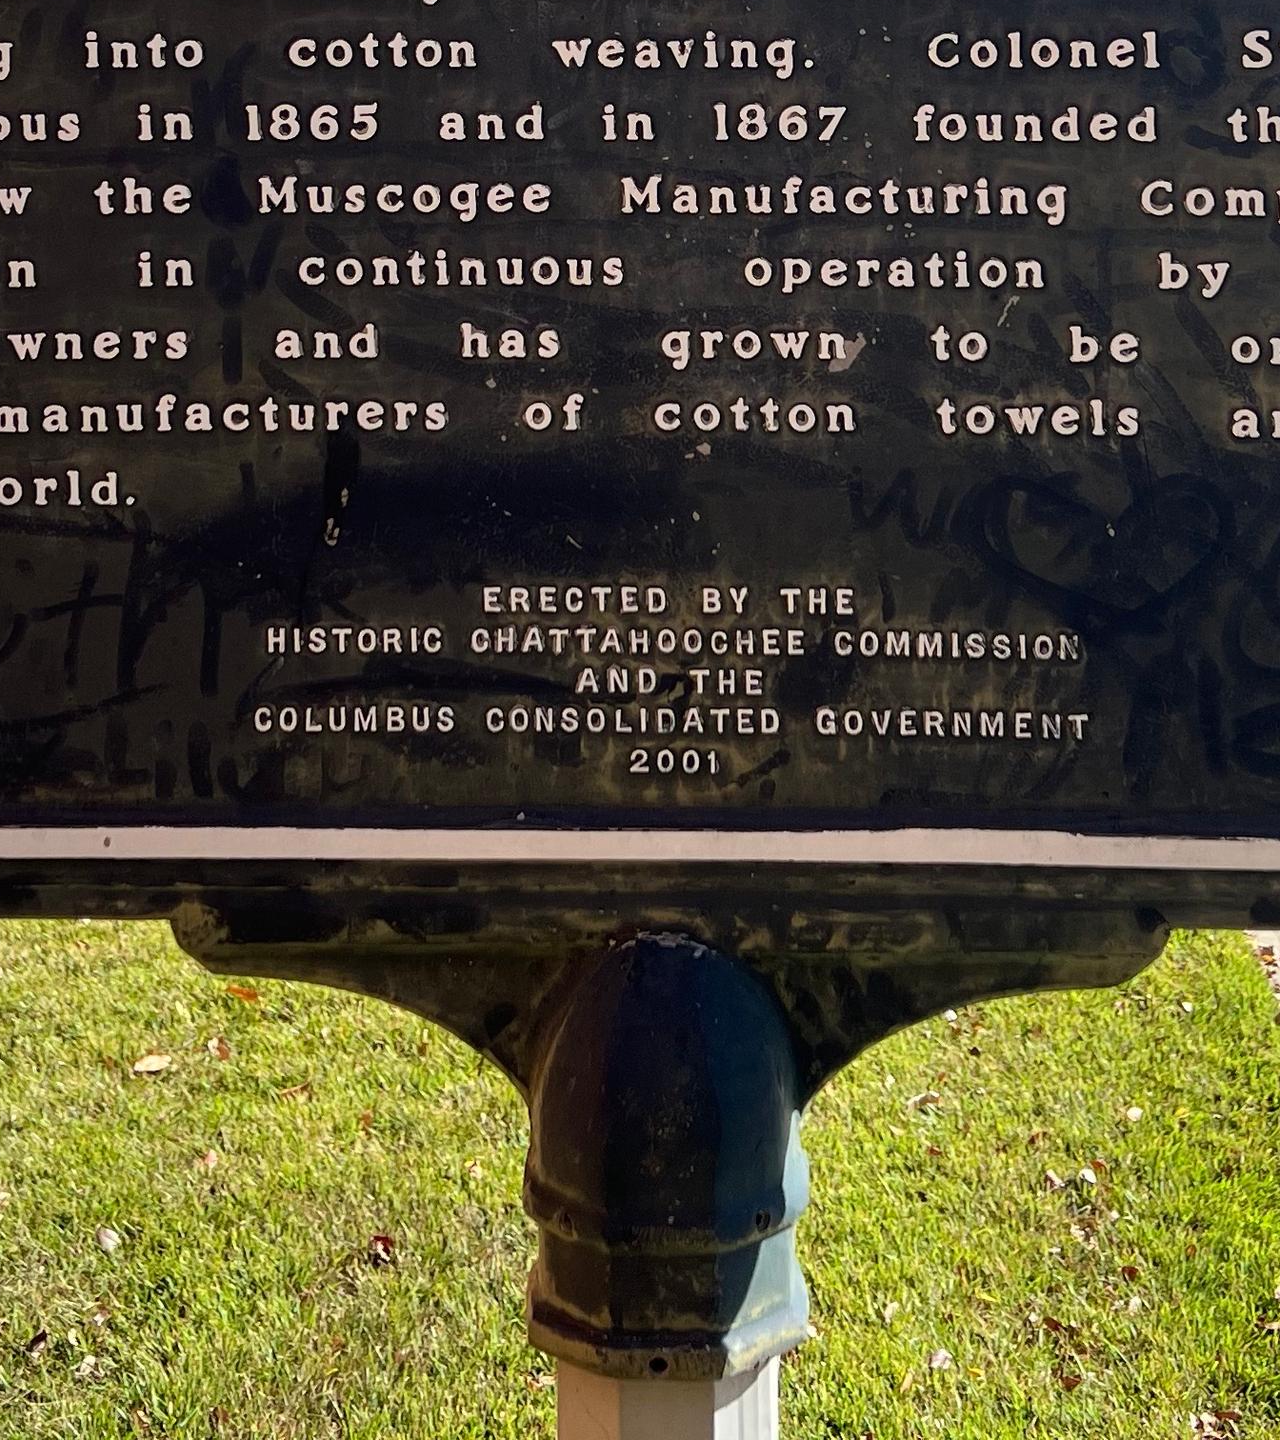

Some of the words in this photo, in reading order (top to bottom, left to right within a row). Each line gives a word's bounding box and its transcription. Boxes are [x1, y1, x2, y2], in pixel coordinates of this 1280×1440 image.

[84, 30, 203, 68] into
[288, 31, 477, 68] cotton
[551, 37, 816, 80] weaving.
[927, 31, 1161, 69] Colonel
[137, 103, 193, 141] in
[245, 102, 378, 141] 1865
[439, 104, 545, 141] and
[601, 103, 655, 141] in
[713, 102, 847, 141] 1867
[912, 104, 1157, 143] founded
[93, 177, 192, 215] the
[258, 176, 551, 222] Muscogee
[620, 173, 1067, 226] Manufacturing
[137, 251, 194, 288] in
[298, 249, 624, 286] continuous
[744, 250, 1045, 294] operation
[1158, 251, 1230, 299] by
[274, 323, 378, 359] and
[460, 322, 560, 359] has
[661, 329, 848, 372] grown
[930, 325, 988, 362] to
[1069, 325, 1139, 363] be
[522, 393, 584, 431] of
[654, 397, 855, 434] cotton
[936, 398, 1139, 436] towels
[483, 586, 666, 614] ERECTED
[702, 586, 748, 614] BY
[779, 587, 854, 615] THE
[267, 627, 442, 654] HISTORIC
[471, 626, 805, 656] CHATTAHOOCHEE
[834, 630, 1078, 660] COMMISSION
[575, 667, 657, 694] AND
[689, 669, 763, 695] THE
[254, 705, 454, 732] COLUMBUS
[486, 706, 780, 734] CONSOLIDATED
[816, 707, 1089, 740] GOVERNMENT
[629, 748, 716, 774] 2001
